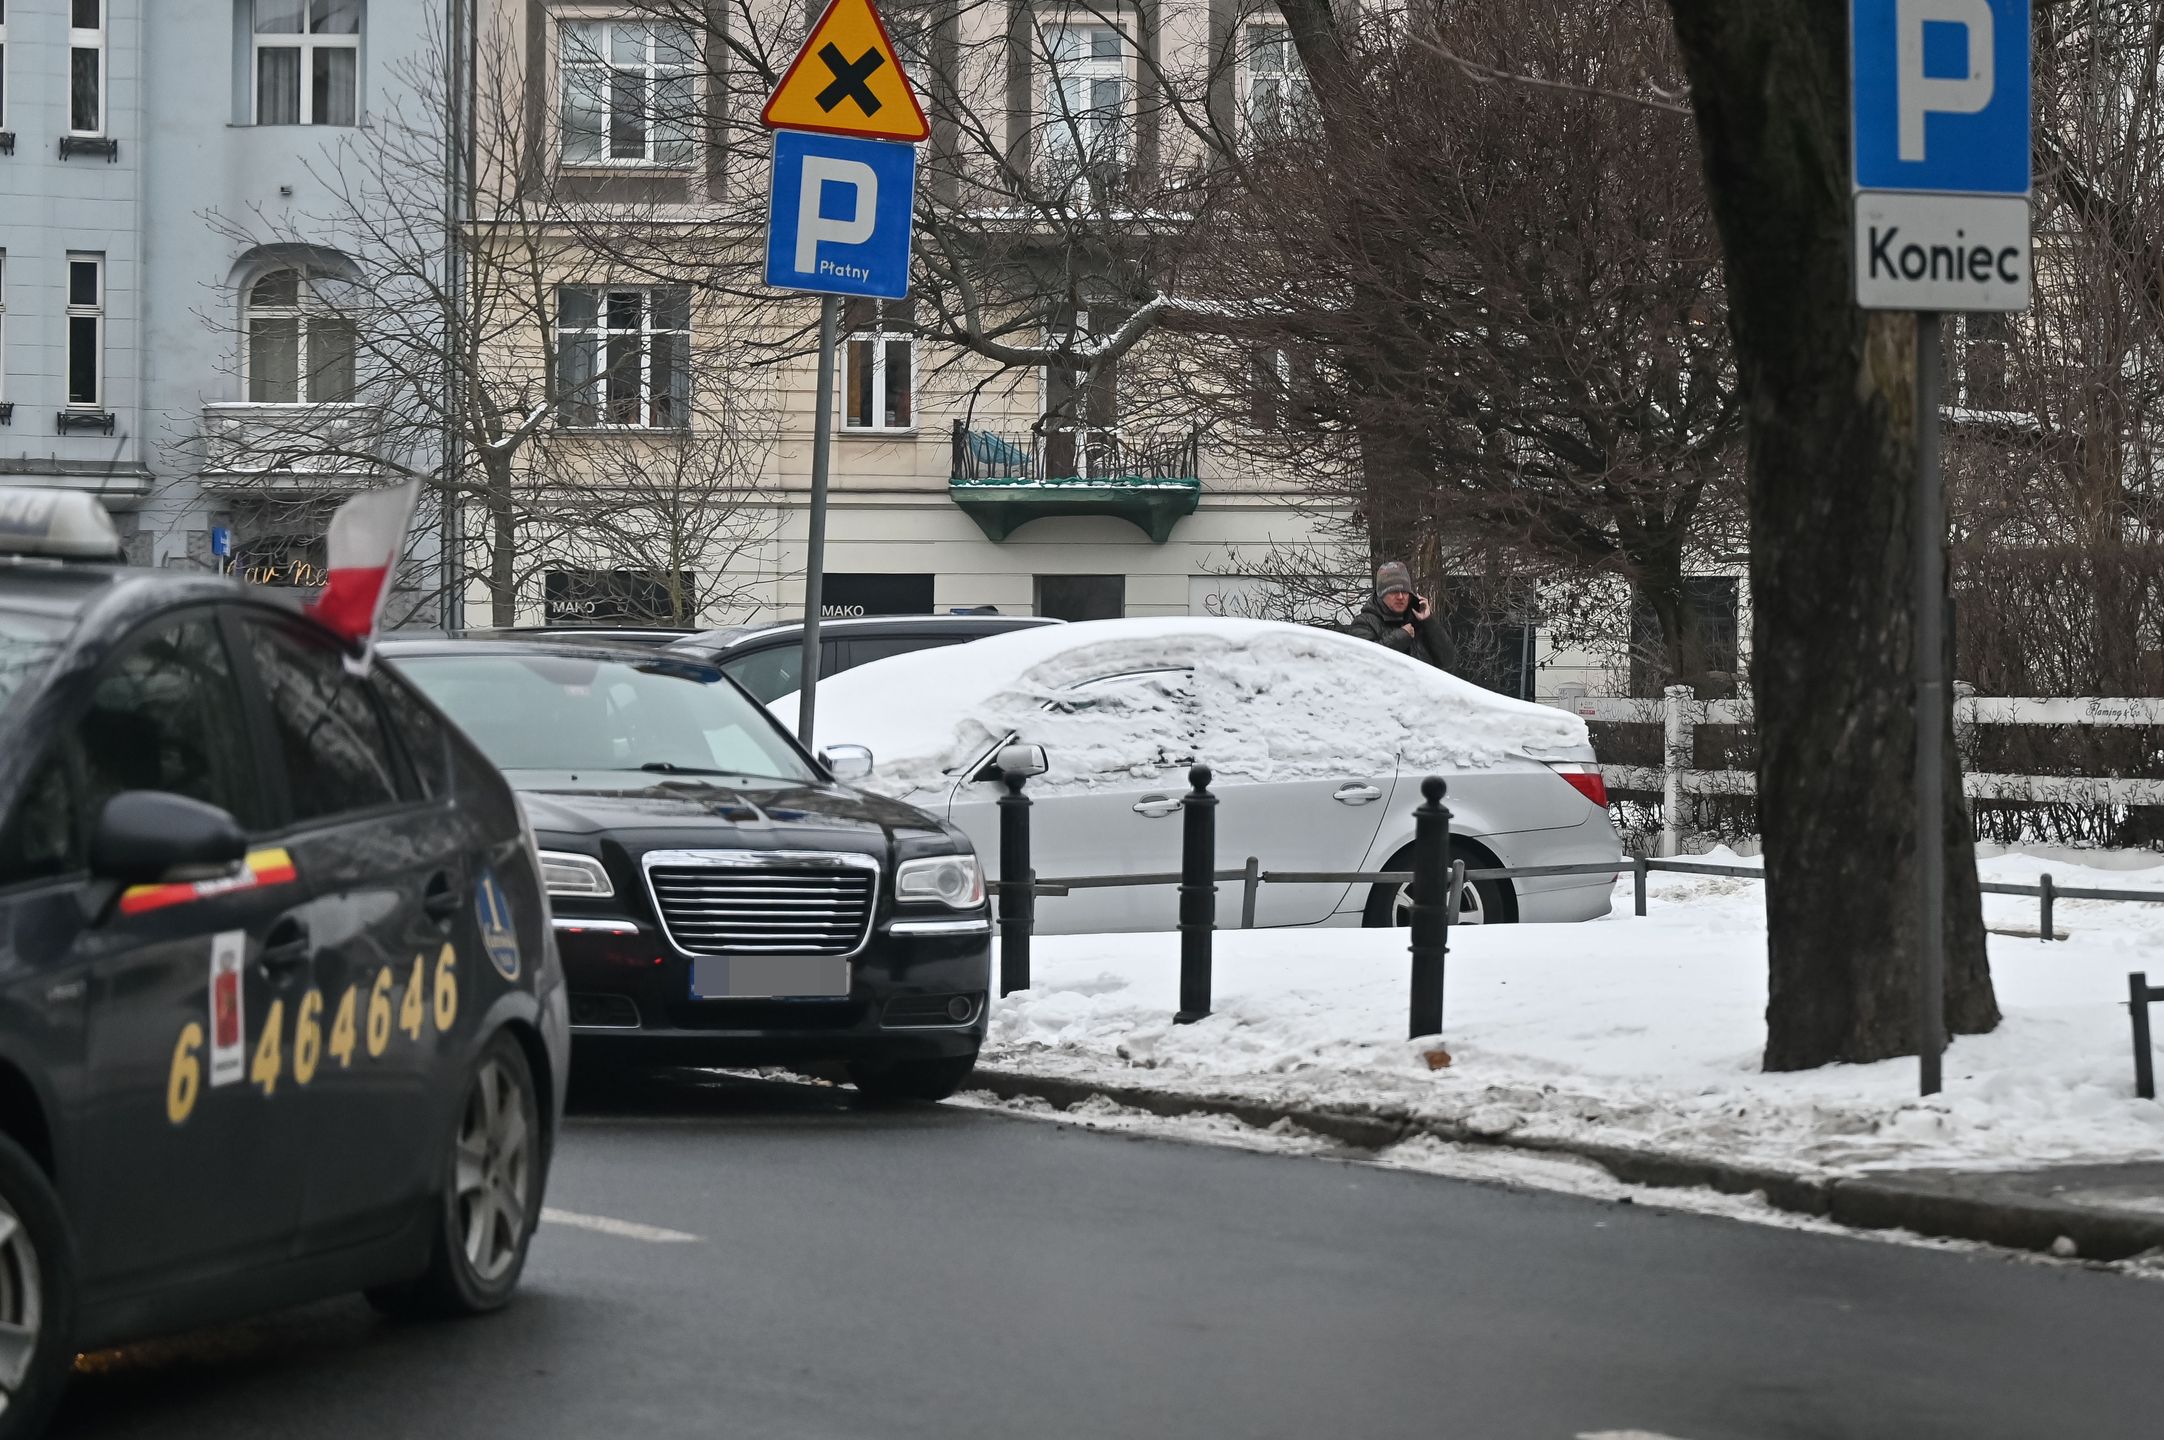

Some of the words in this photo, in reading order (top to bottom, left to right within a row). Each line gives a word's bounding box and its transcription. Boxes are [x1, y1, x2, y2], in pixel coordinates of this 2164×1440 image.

[1895, 0, 1995, 162] P
[795, 154, 878, 274] P
[820, 260, 869, 283] Płatny
[1869, 226, 2020, 284] Koniec
[822, 604, 864, 617] MAKO
